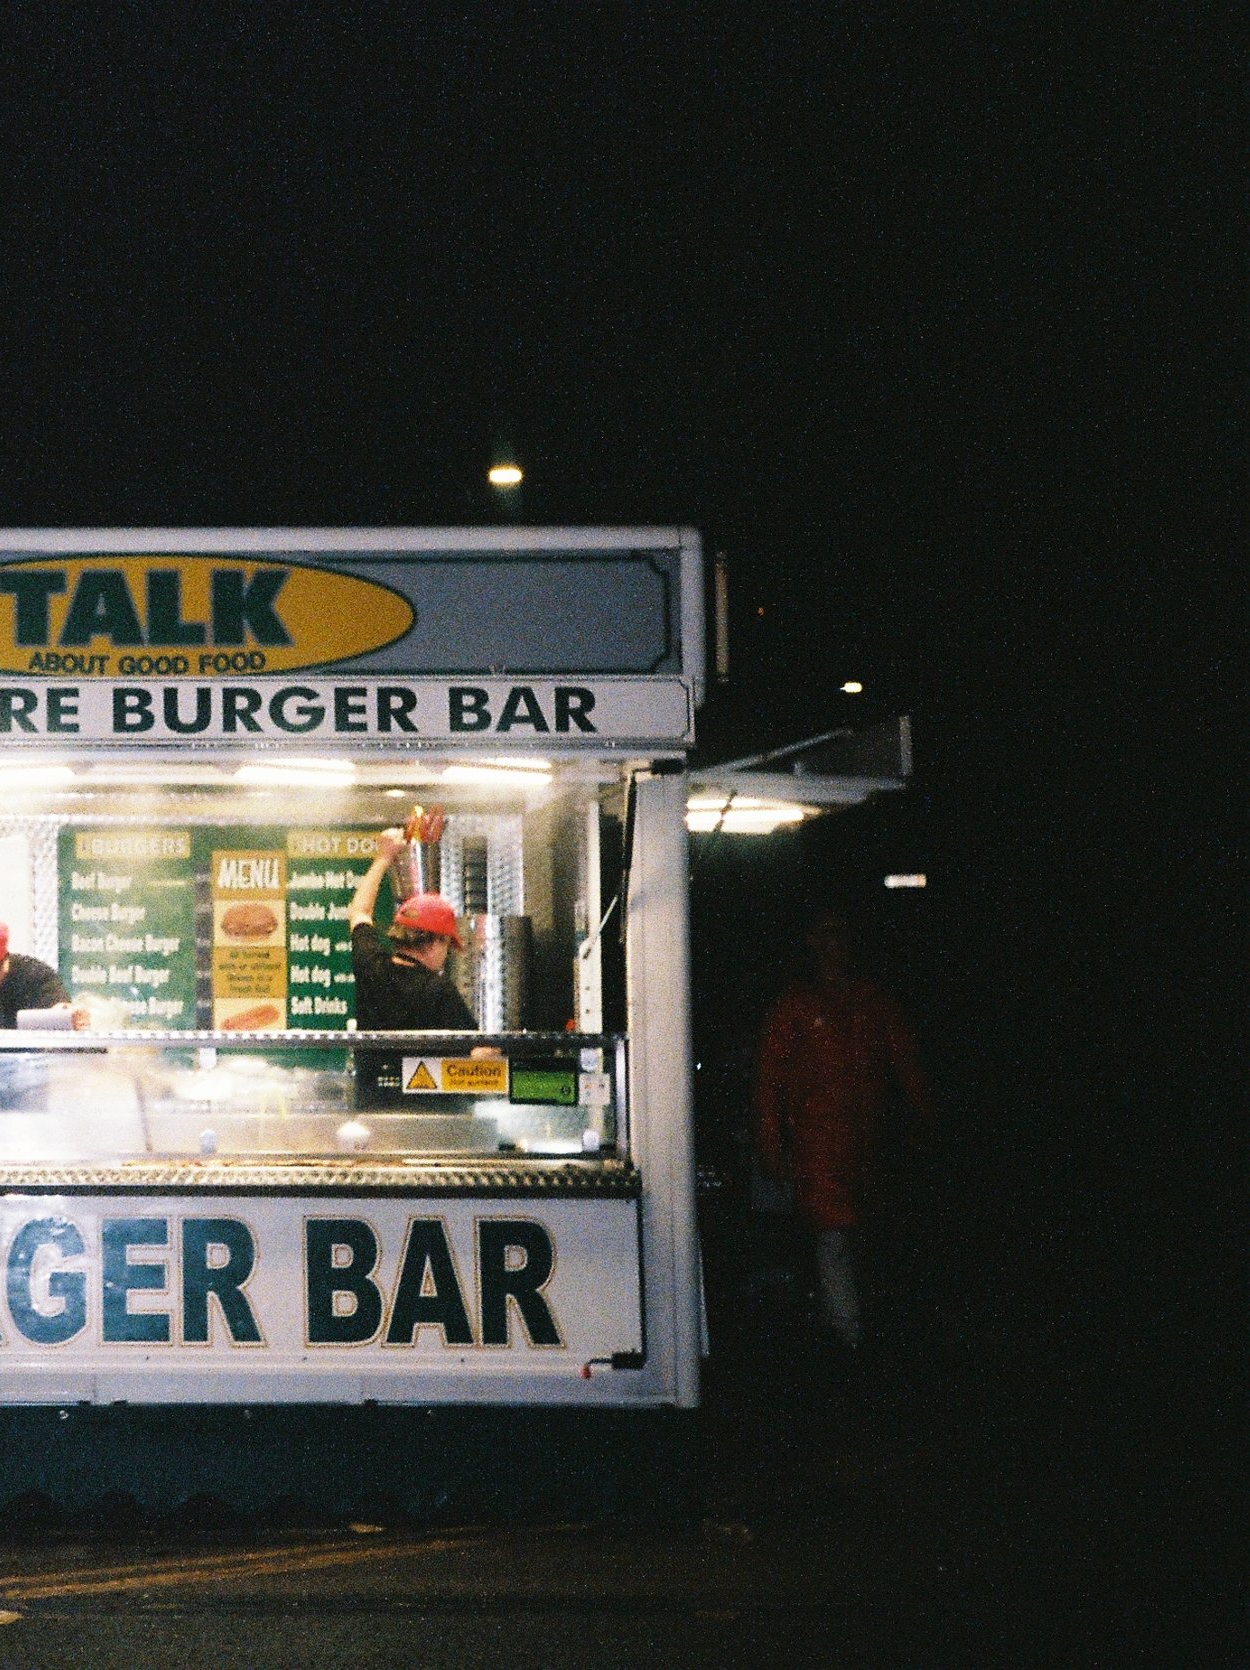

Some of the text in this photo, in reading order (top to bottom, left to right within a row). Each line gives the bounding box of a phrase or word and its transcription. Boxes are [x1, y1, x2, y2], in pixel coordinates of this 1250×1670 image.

[28, 651, 267, 676] ABOUT GOOD FOOD
[112, 685, 419, 735] BURGER
[450, 685, 597, 734] BAR
[302, 837, 341, 854] HOT
[71, 871, 132, 893] Beef Burger
[217, 858, 279, 889] MENU
[325, 871, 344, 889] Hot
[71, 903, 146, 924] Cheese Burger
[290, 902, 325, 920] Double
[71, 934, 104, 952] Bacon
[105, 933, 143, 952] Cheese
[145, 934, 180, 956] Burger
[290, 933, 310, 952] Hot
[311, 933, 330, 957] dog
[71, 965, 170, 988] Double Beef Burger
[290, 965, 310, 984] Hot
[311, 965, 331, 988] dog
[149, 997, 184, 1019] Burger
[291, 996, 347, 1015] Soft Drinks
[447, 1064, 502, 1076] Caution
[303, 1214, 565, 1351] BAR
